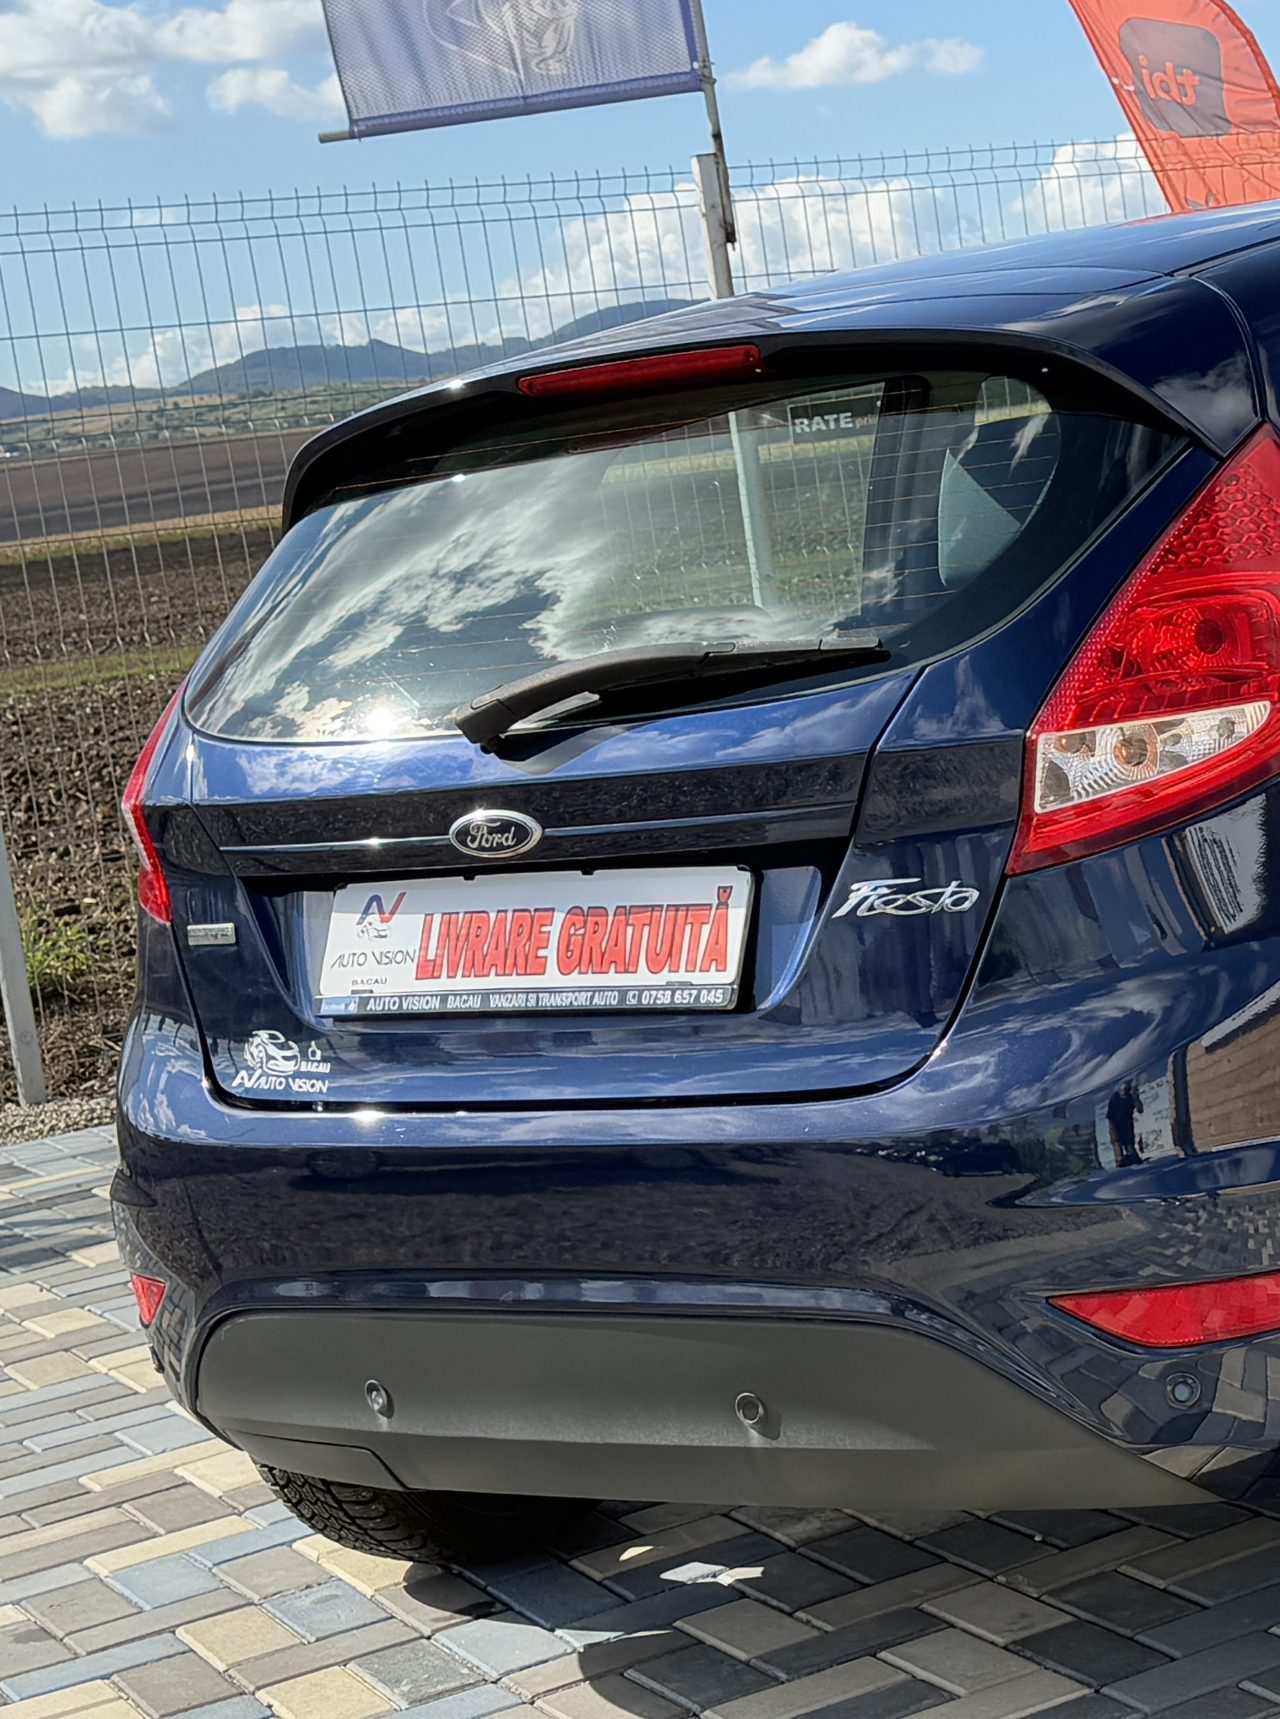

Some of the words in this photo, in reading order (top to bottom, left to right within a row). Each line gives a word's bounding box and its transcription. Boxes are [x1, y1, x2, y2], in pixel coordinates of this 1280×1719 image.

[794, 412, 854, 433] RATE
[466, 821, 517, 849] Ford
[831, 877, 980, 919] Fiesta
[415, 911, 554, 981] LIVRARE
[556, 885, 734, 977] GRATUITĂ
[330, 951, 368, 969] AUTO
[371, 949, 417, 966] VISION
[366, 997, 400, 1011] AUTO
[401, 995, 441, 1010] VISION
[446, 994, 482, 1009] BACAU
[537, 991, 593, 1008] TRANSPORT
[592, 990, 619, 1006] AUTO
[674, 989, 698, 1005] 657
[700, 988, 724, 1004] 045
[253, 1076, 286, 1090] AUTO
[288, 1076, 329, 1093] VISION
